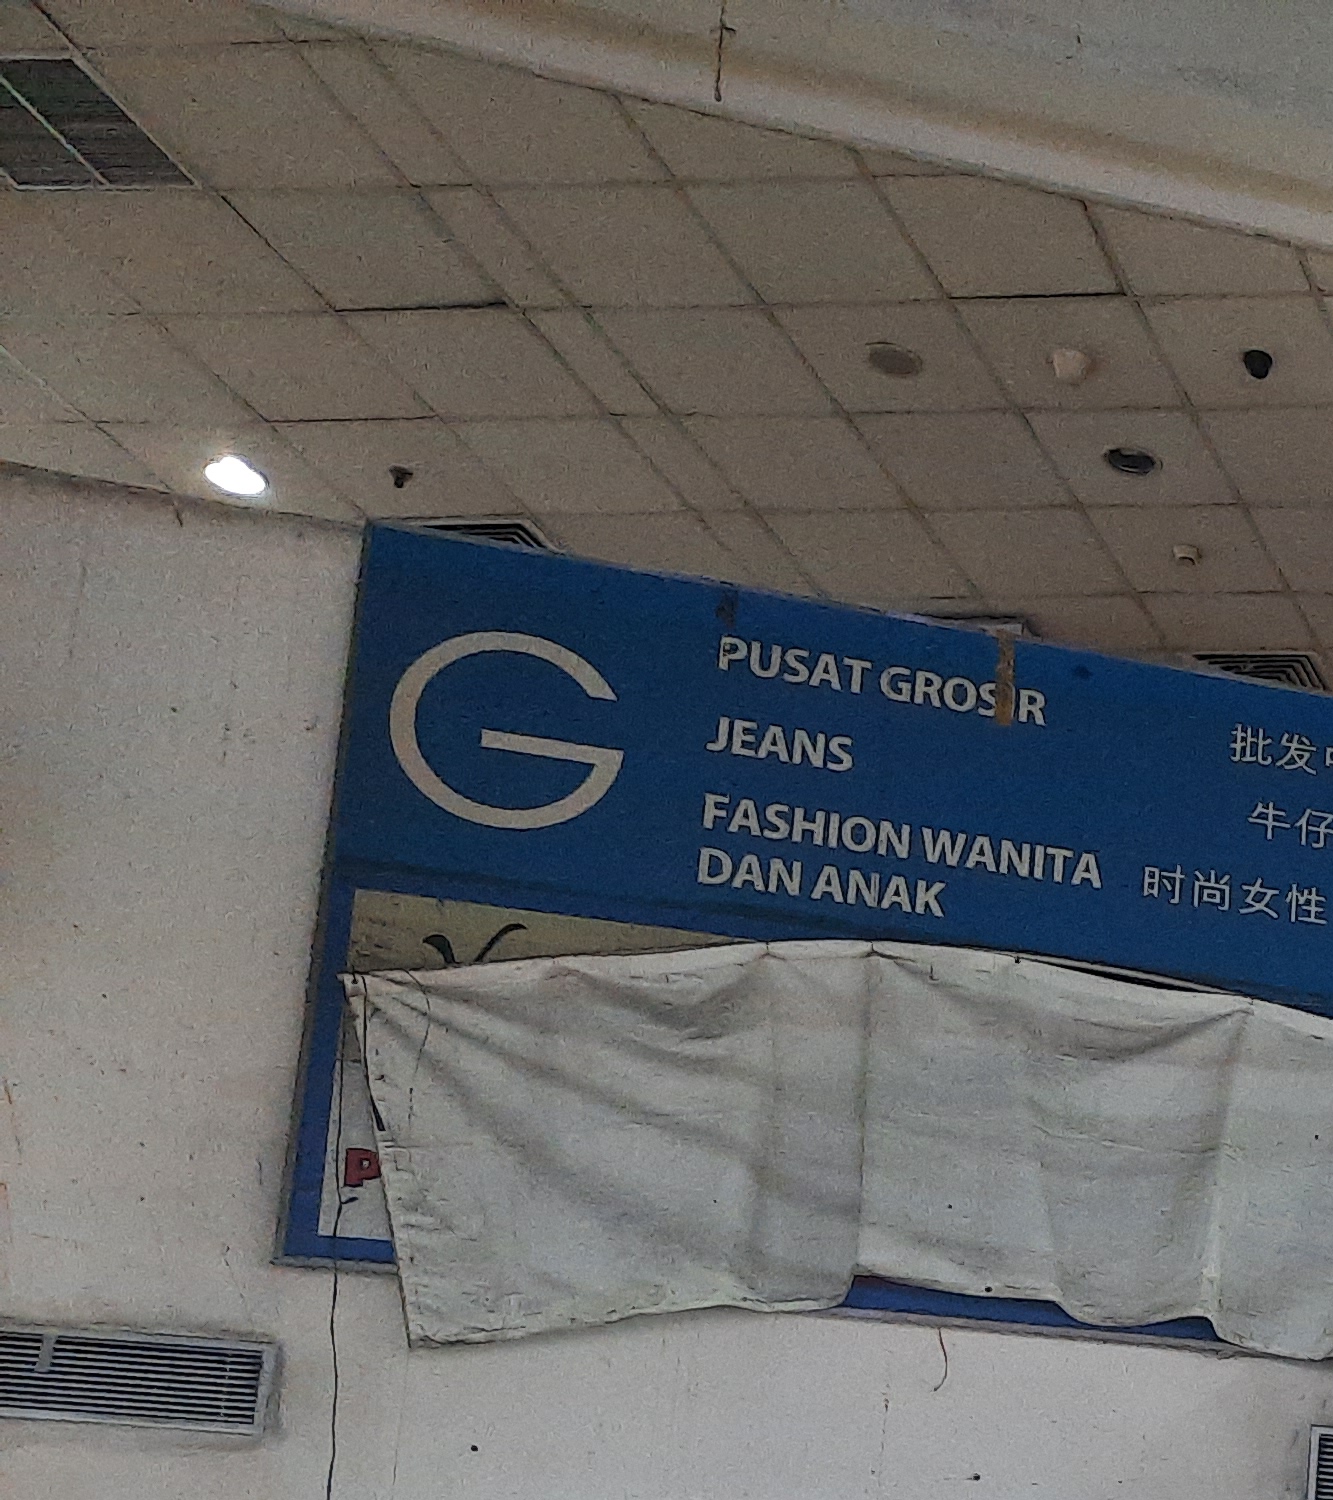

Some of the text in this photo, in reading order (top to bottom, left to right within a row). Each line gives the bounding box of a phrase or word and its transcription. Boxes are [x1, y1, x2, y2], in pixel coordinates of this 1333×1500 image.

[717, 635, 873, 694] PUSAT
[389, 631, 624, 830] G
[706, 716, 854, 772] JEANS
[702, 793, 1102, 889] FASHION WANITA
[697, 846, 946, 918] DAN ANAK
[1143, 864, 1328, 925] 时尚女性
